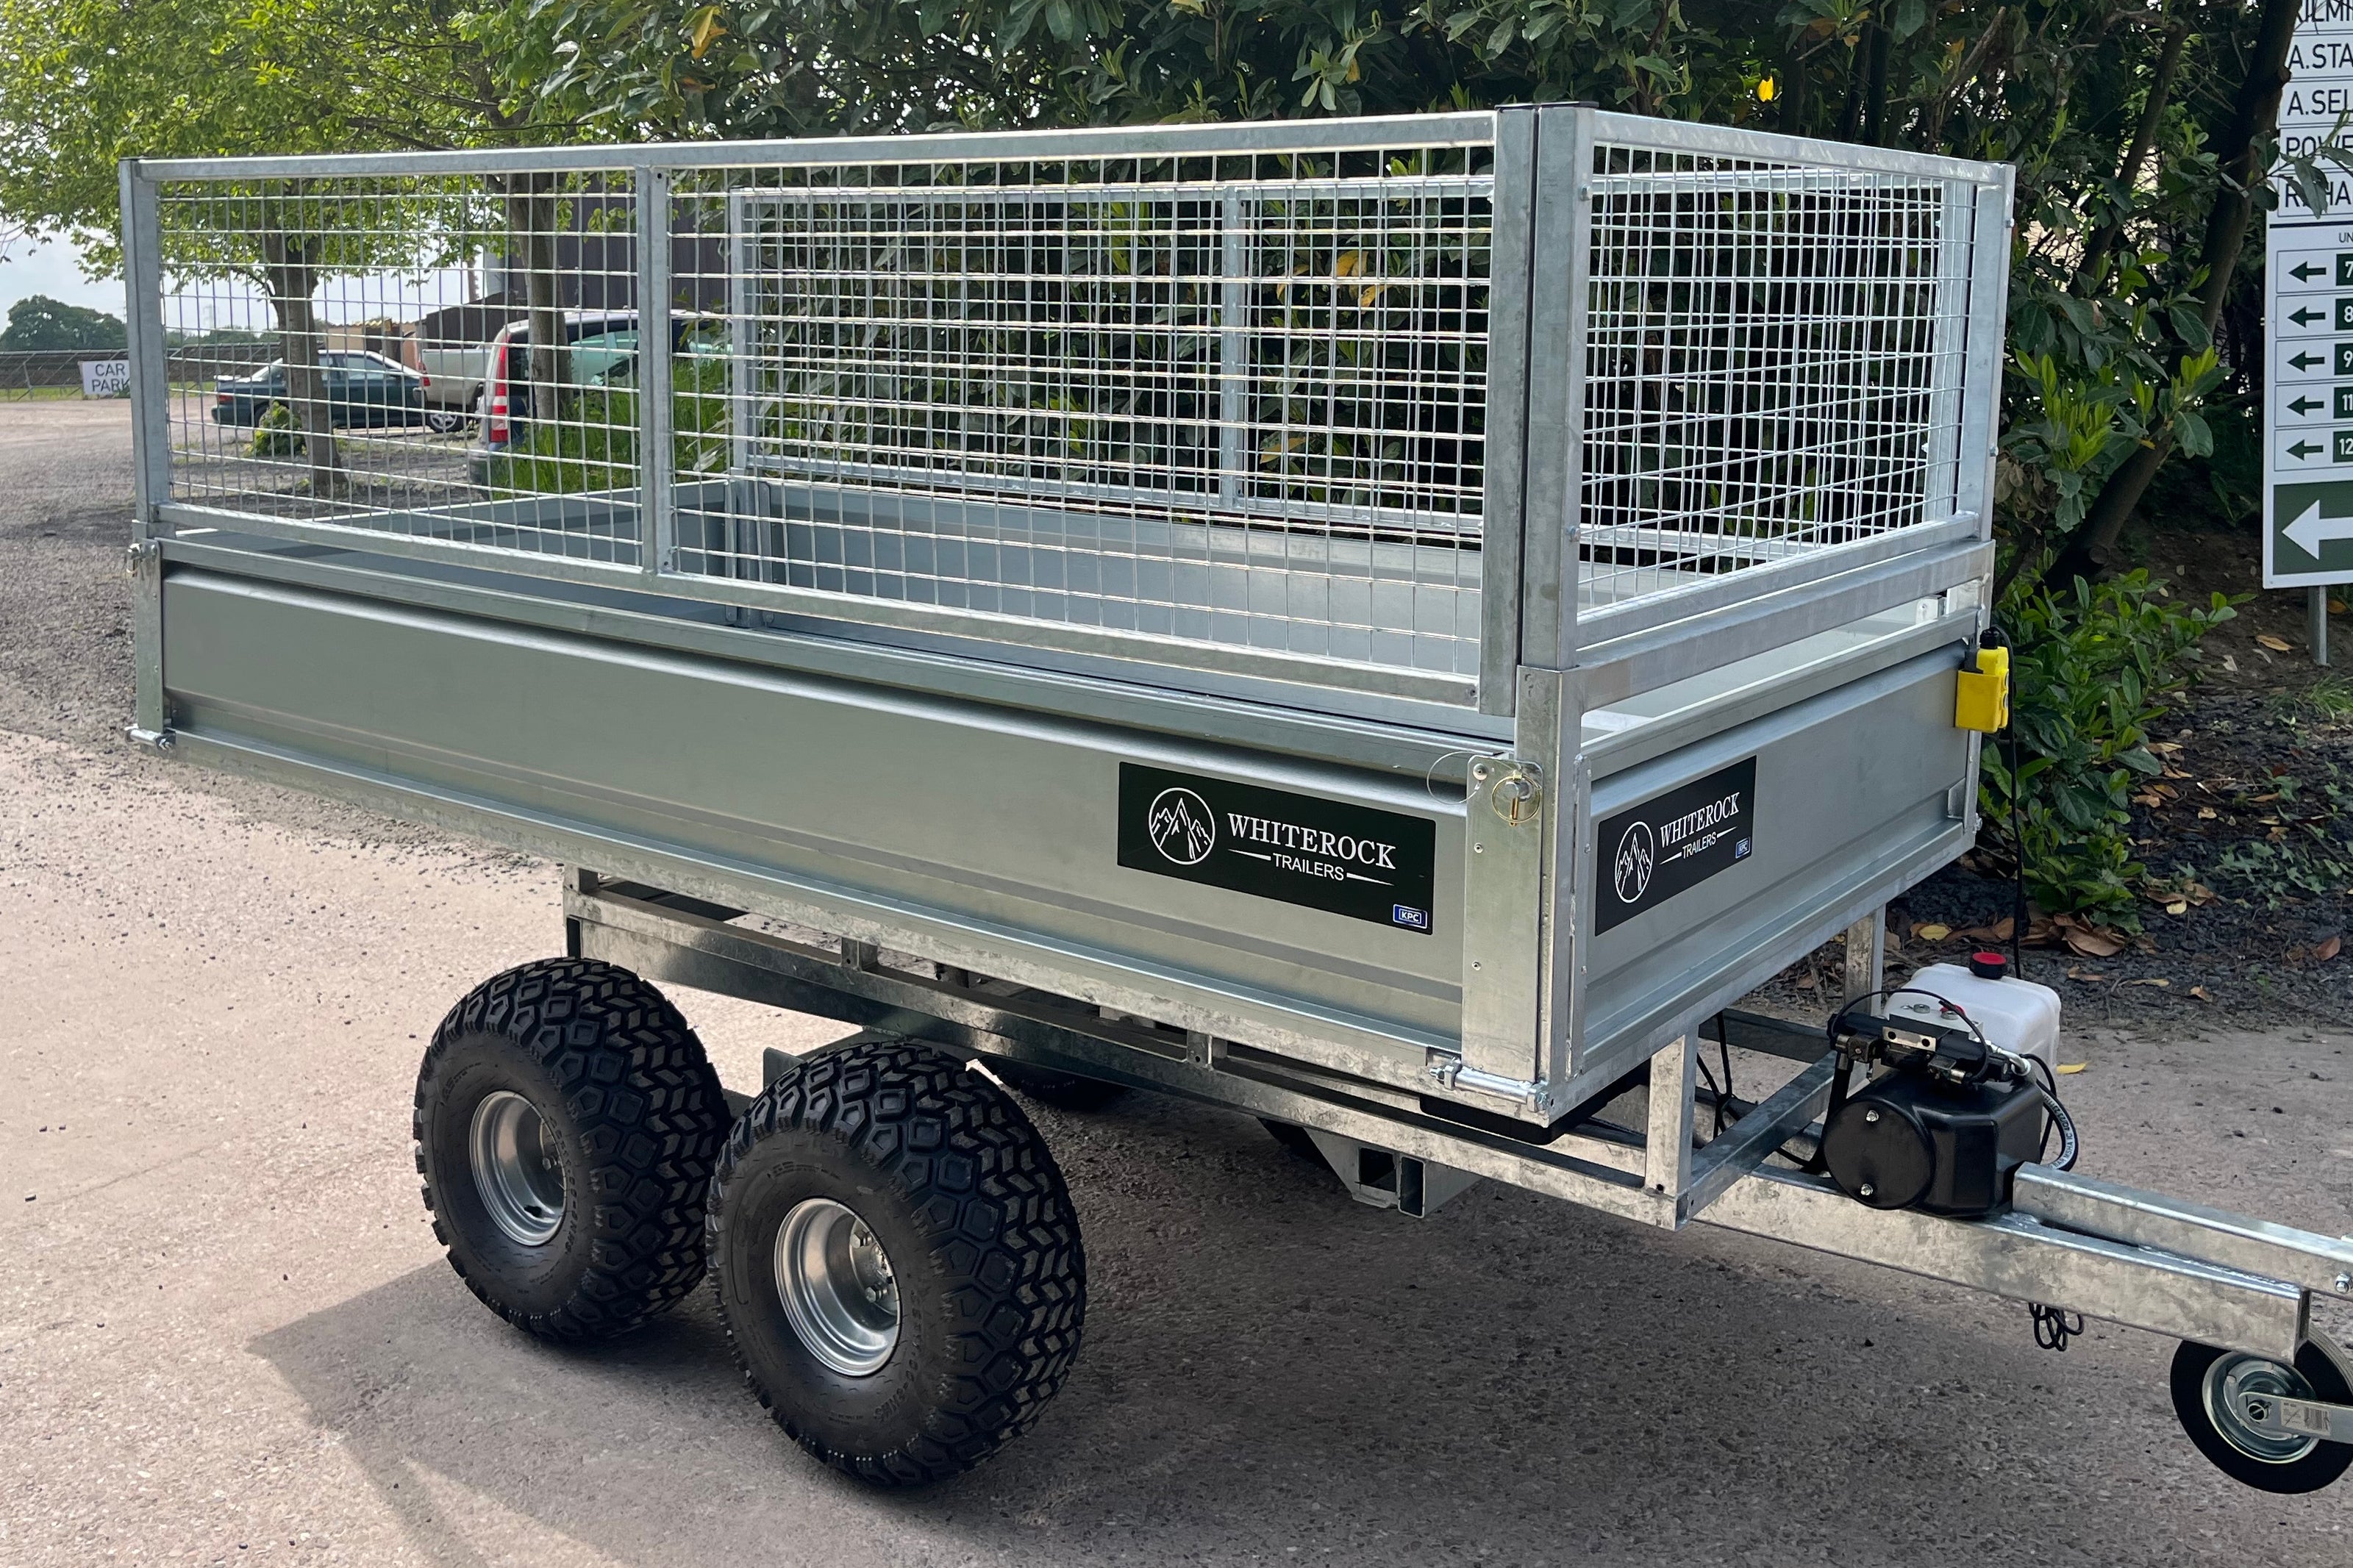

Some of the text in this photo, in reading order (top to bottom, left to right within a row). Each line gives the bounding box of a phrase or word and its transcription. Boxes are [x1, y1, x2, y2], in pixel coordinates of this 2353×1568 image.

[2344, 260, 2353, 279] 7
[2343, 305, 2353, 323] 8
[2343, 350, 2353, 368] 9
[95, 362, 126, 376] CAR
[92, 378, 130, 393] PARK
[2339, 437, 2353, 456] 12
[1660, 792, 1740, 848] WHITEROCK
[1227, 812, 1396, 870] WHITEROCK
[1682, 831, 1717, 859] TRAILERS
[1272, 852, 1345, 881] TRAILERS
[1402, 911, 1419, 922] KPC
